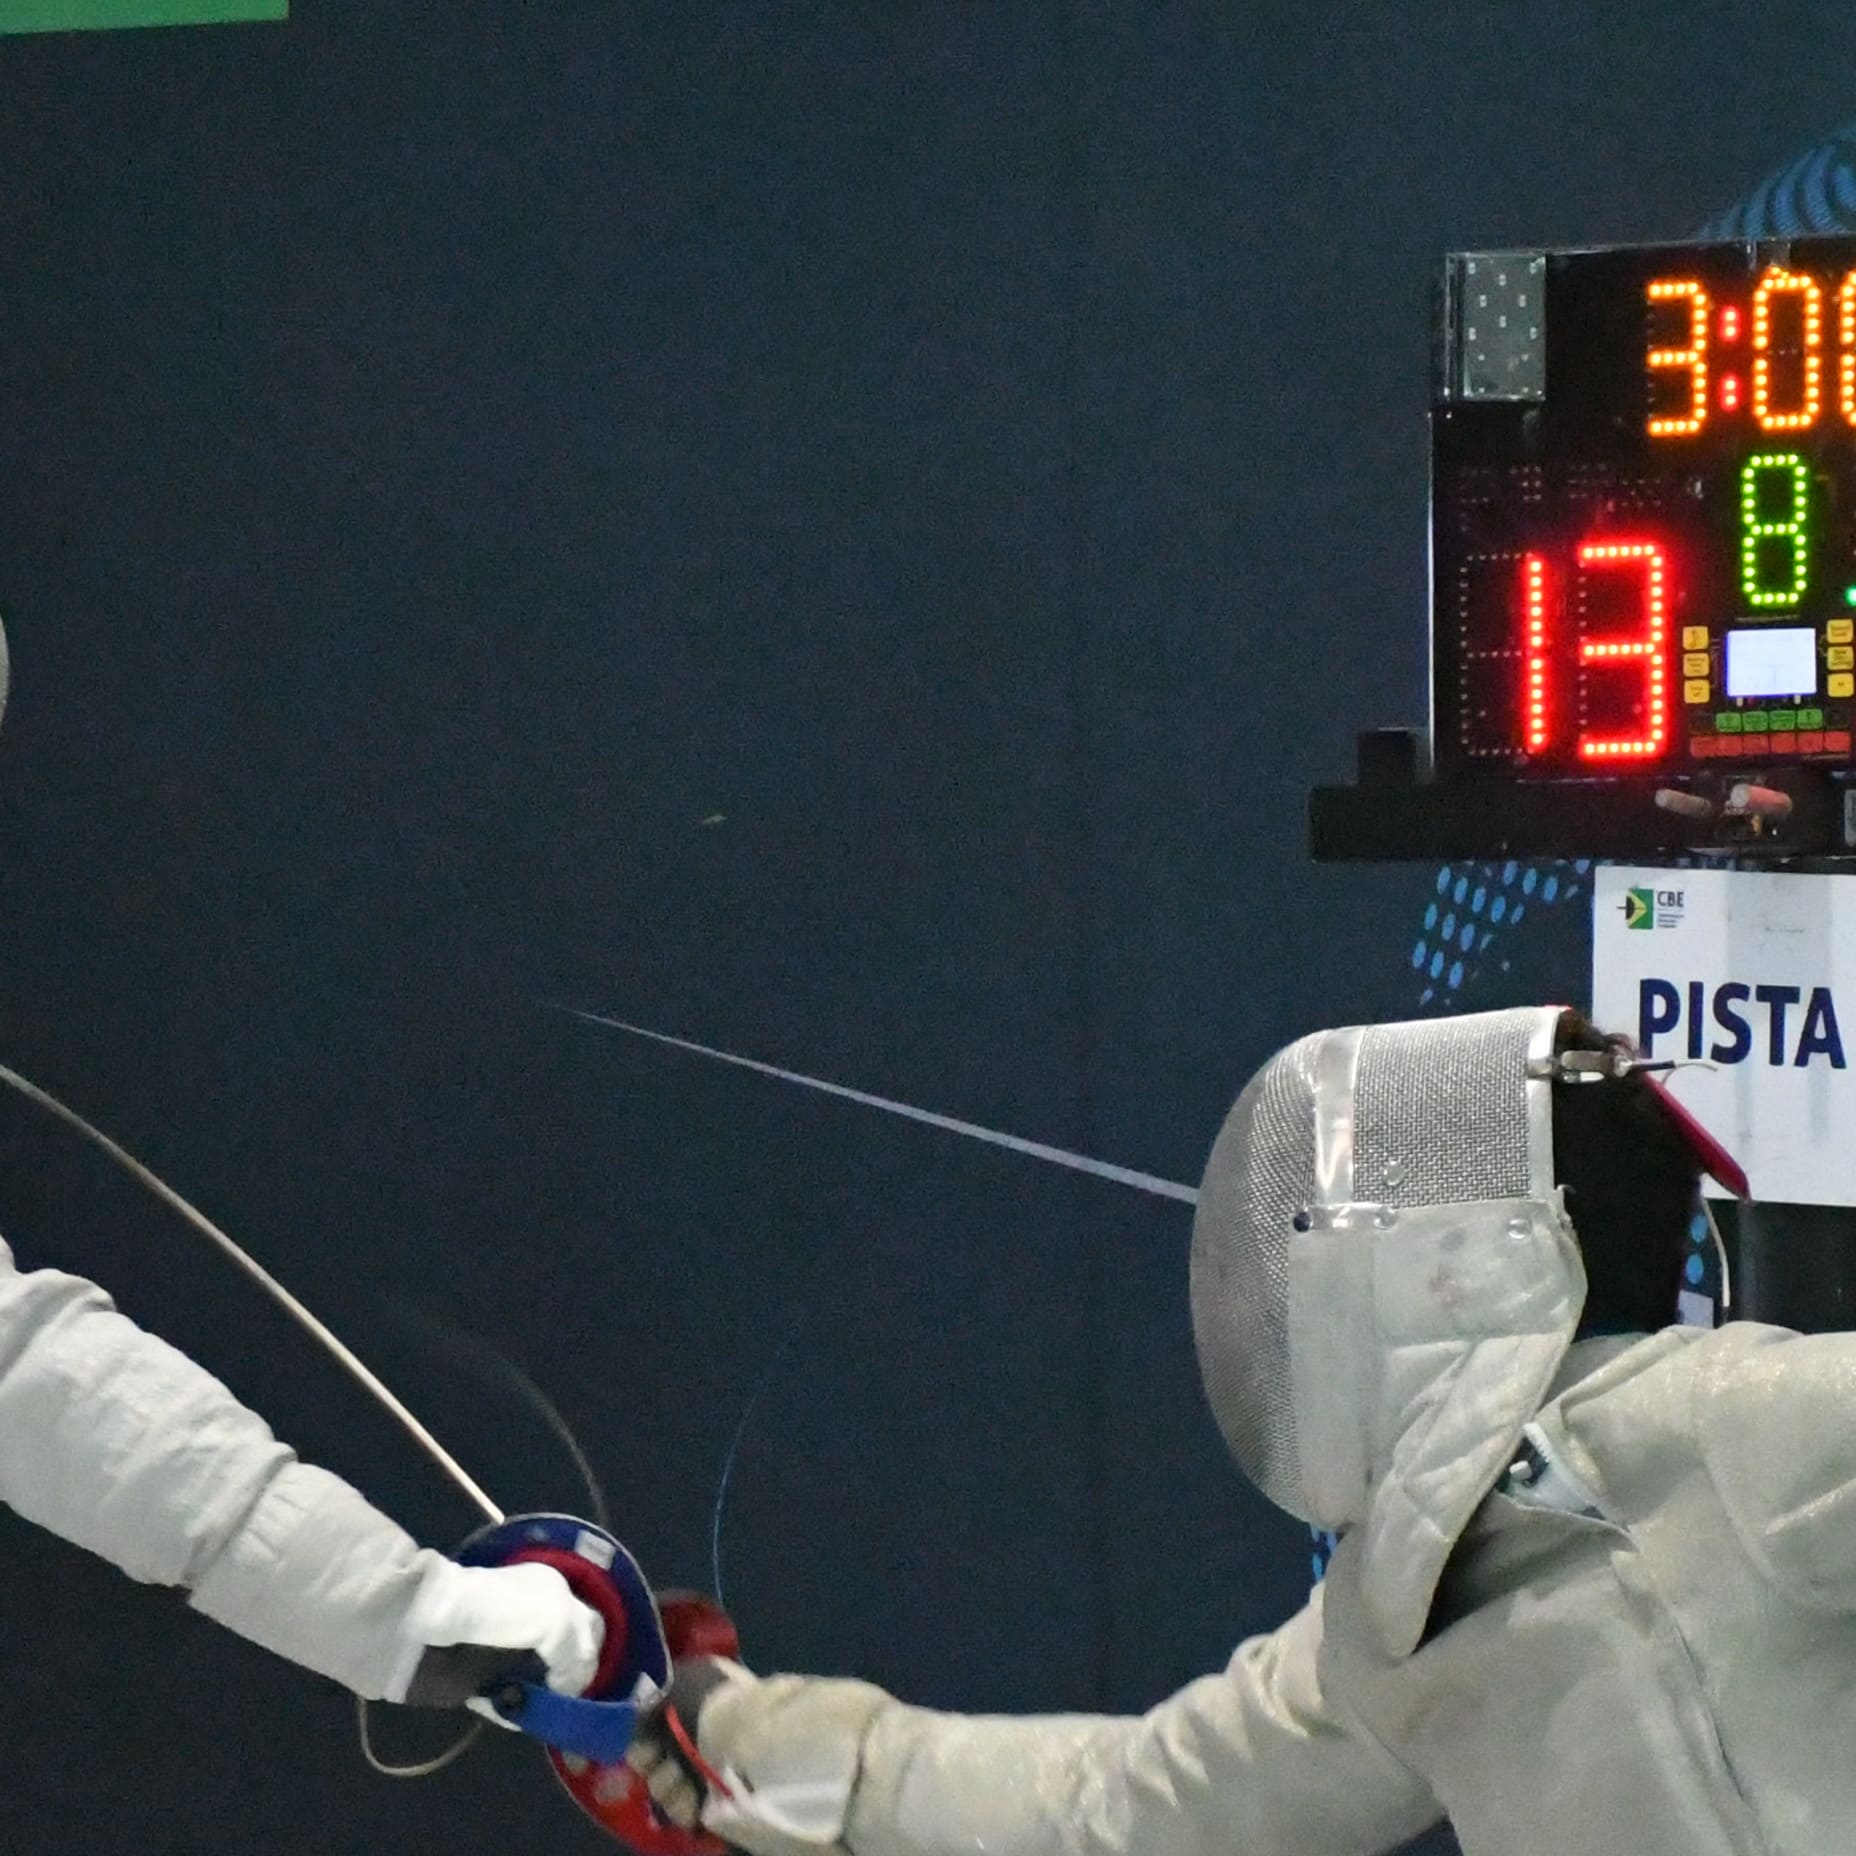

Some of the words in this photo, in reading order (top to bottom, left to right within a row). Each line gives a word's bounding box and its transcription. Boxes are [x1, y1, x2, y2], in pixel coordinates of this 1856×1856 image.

[1741, 452, 1808, 607] 8
[1524, 537, 1666, 758] 13
[1657, 890, 1685, 908] CBE
[1639, 977, 1847, 1070] PISTA
